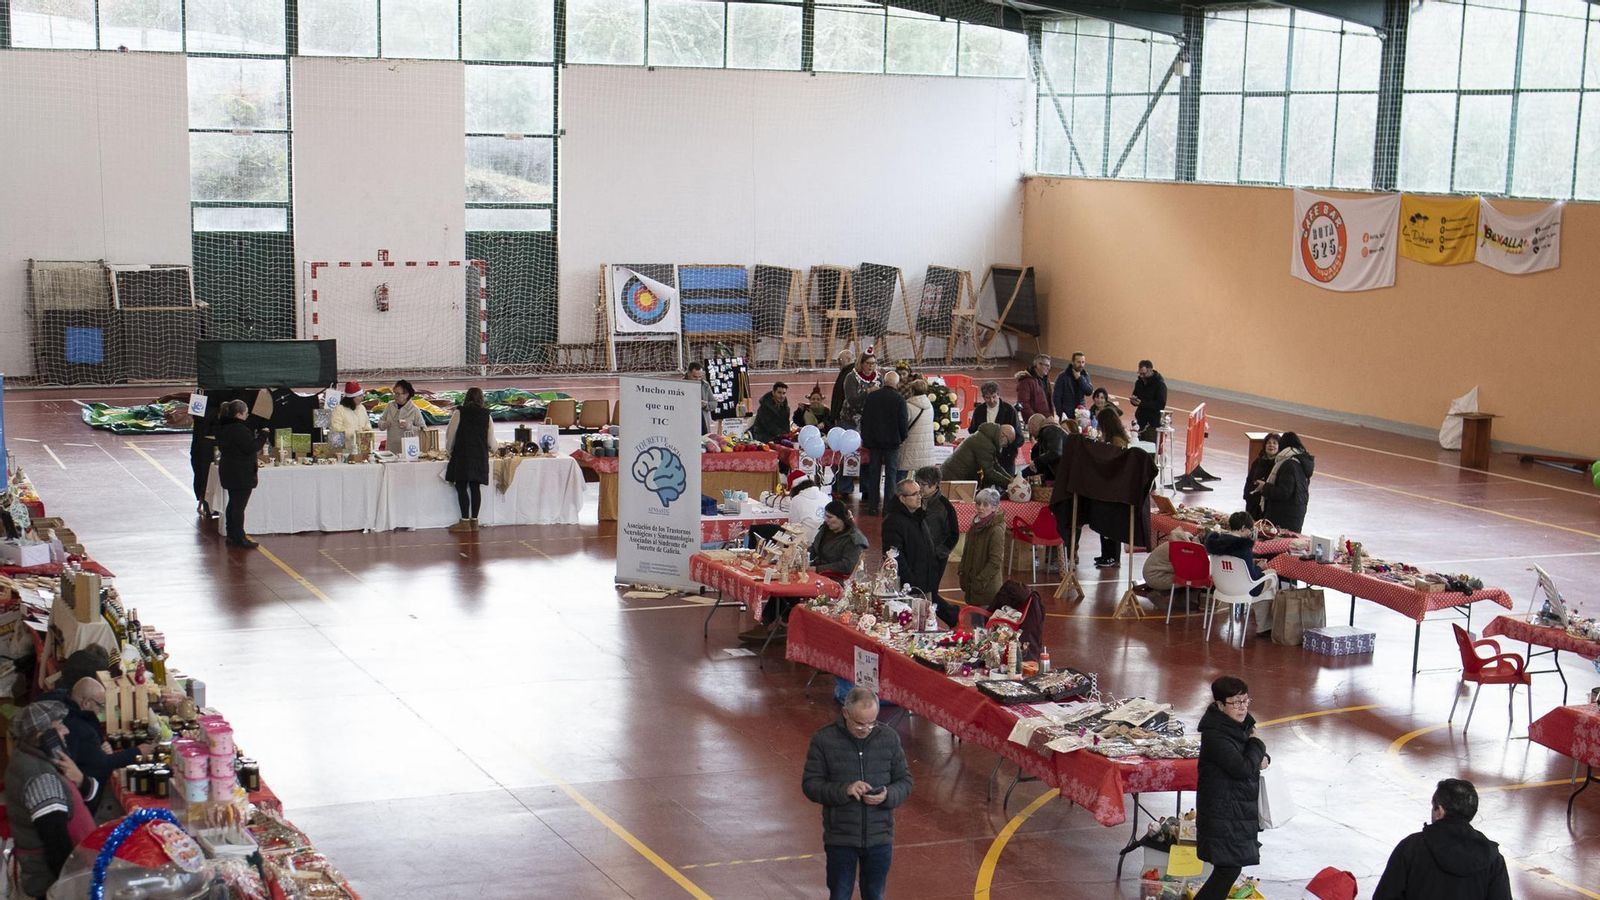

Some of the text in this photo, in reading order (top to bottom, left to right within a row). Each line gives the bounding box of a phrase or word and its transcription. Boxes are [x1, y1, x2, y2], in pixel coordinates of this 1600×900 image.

[1323, 205, 1343, 228] BAR
[1312, 239, 1336, 260] 525
[635, 384, 685, 396] Mucho más
[645, 403, 662, 411] que
[651, 417, 669, 426] TIC
[634, 435, 667, 453] TOURETTE
[626, 523, 651, 531] Asociación
[658, 525, 666, 533] los
[666, 526, 691, 535] Trastornos
[636, 544, 656, 552] Tourette
